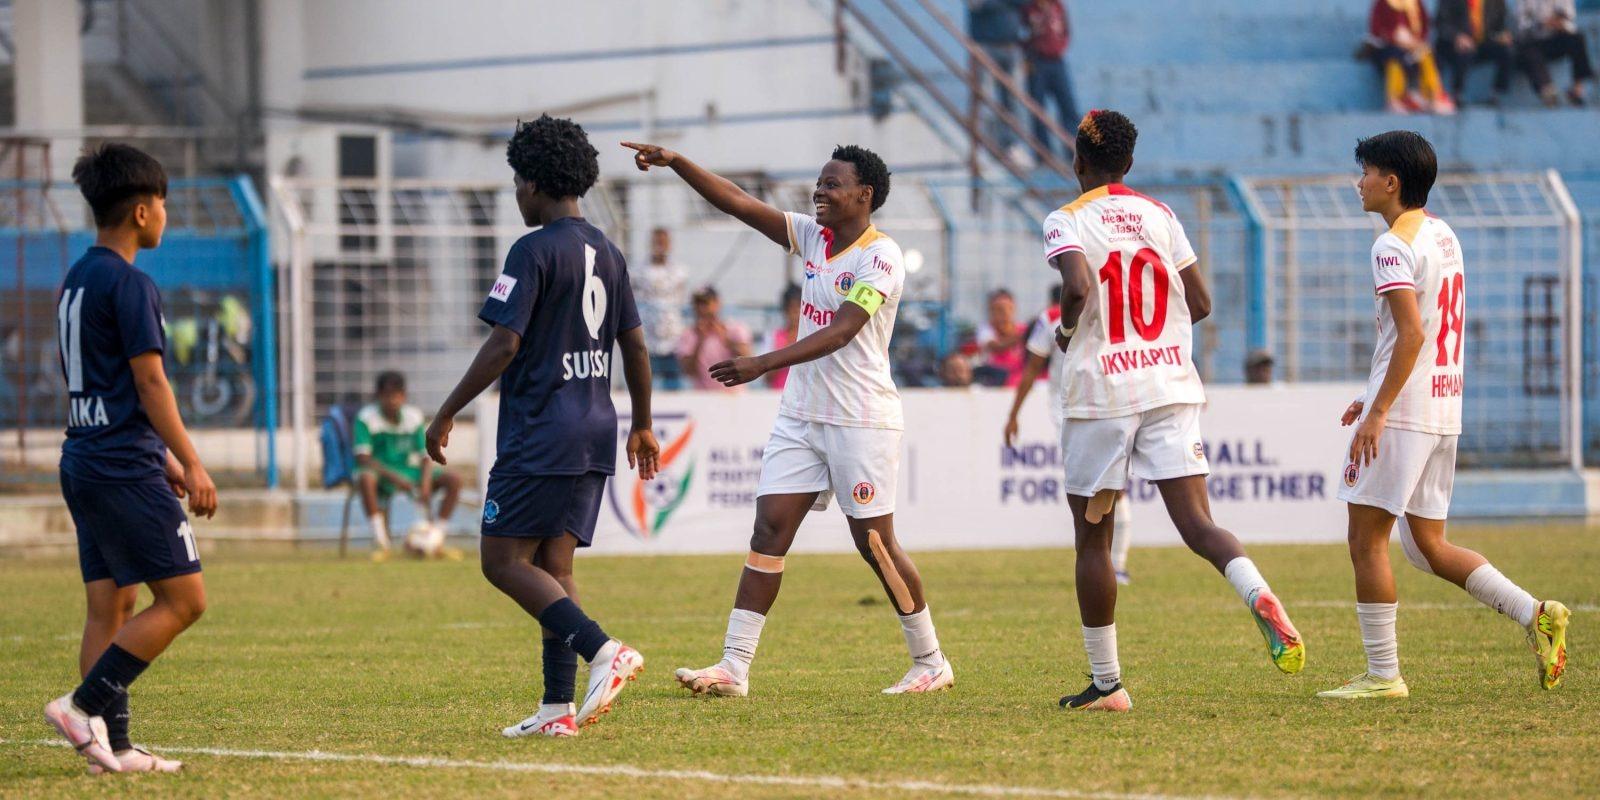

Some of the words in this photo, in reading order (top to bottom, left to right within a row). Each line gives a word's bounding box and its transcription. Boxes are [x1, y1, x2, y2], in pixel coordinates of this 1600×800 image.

[582, 243, 607, 340] 6
[855, 286, 873, 305] C
[1099, 247, 1169, 345] 10
[1436, 272, 1464, 366] 19
[59, 287, 84, 392] 11
[1101, 345, 1182, 376] IKWAPUT
[1000, 445, 1058, 467] INDI
[1208, 473, 1326, 500] GETHER
